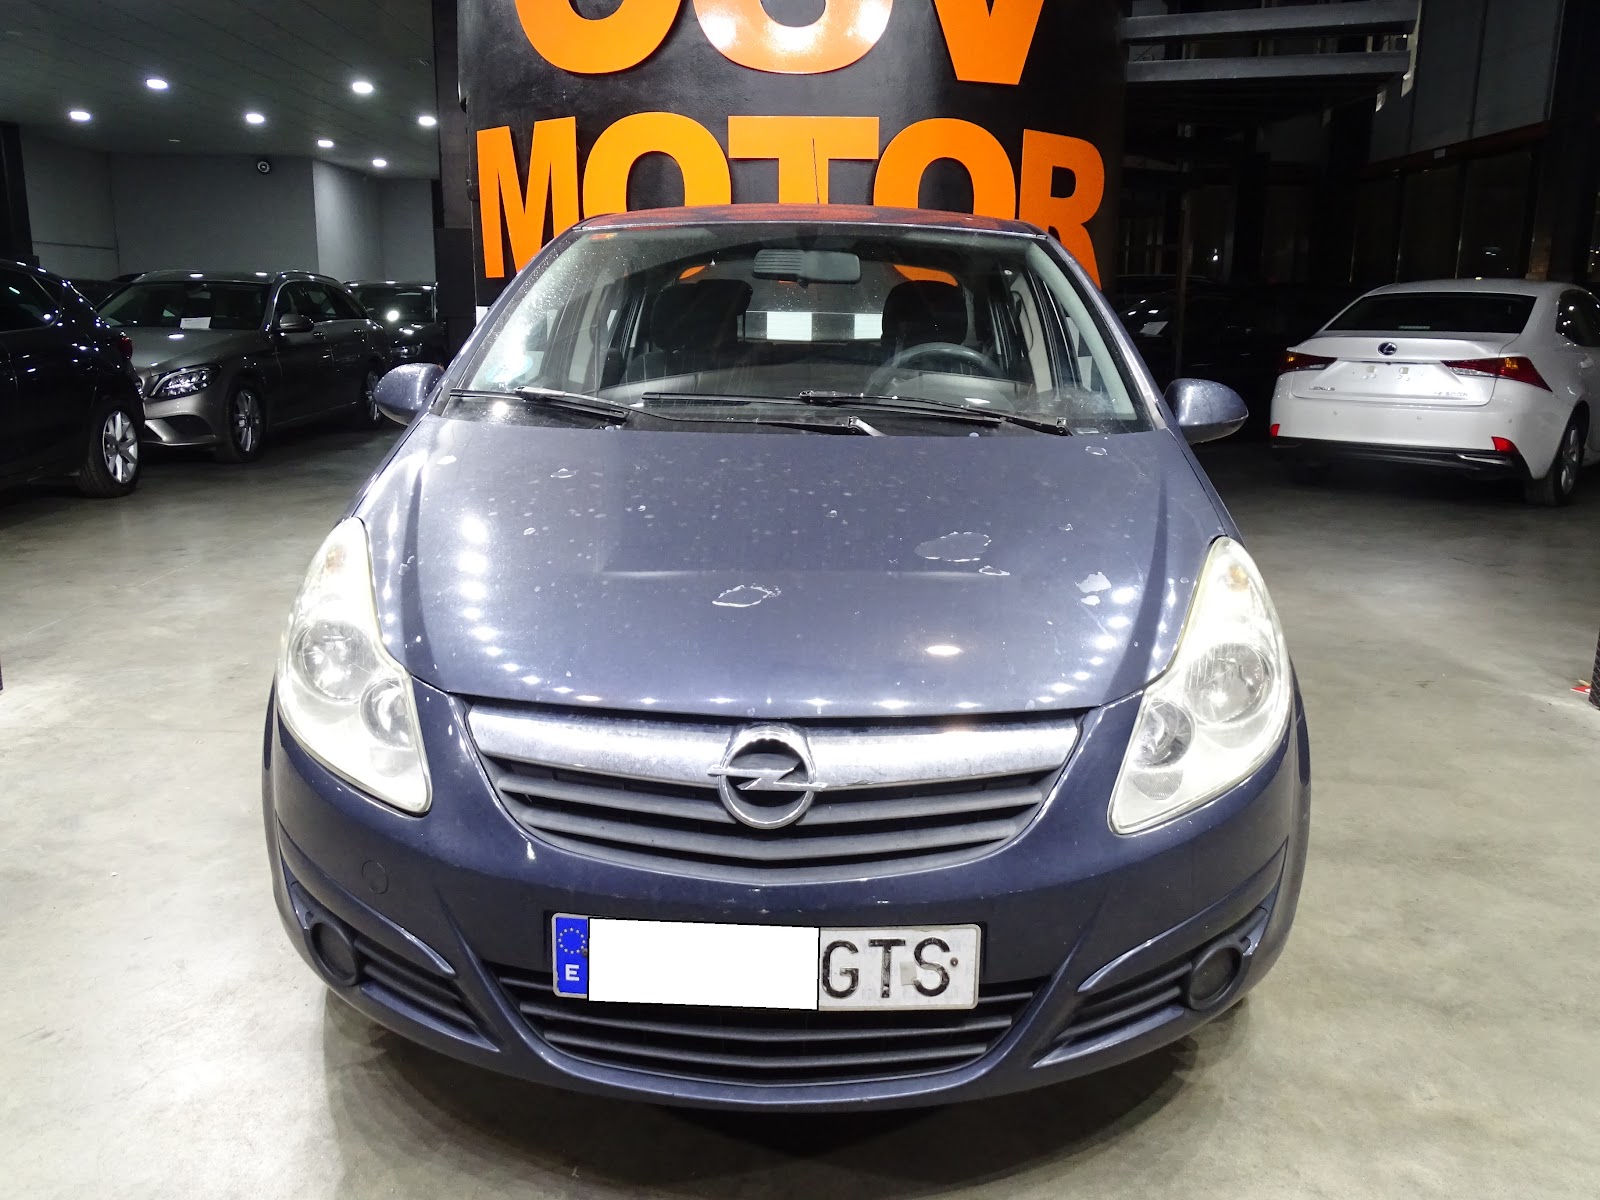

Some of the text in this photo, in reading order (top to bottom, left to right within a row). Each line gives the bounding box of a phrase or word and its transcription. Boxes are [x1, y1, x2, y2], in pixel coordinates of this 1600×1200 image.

[476, 111, 1105, 290] MOTOR
[565, 963, 580, 982] E
[822, 937, 950, 999] GTS
